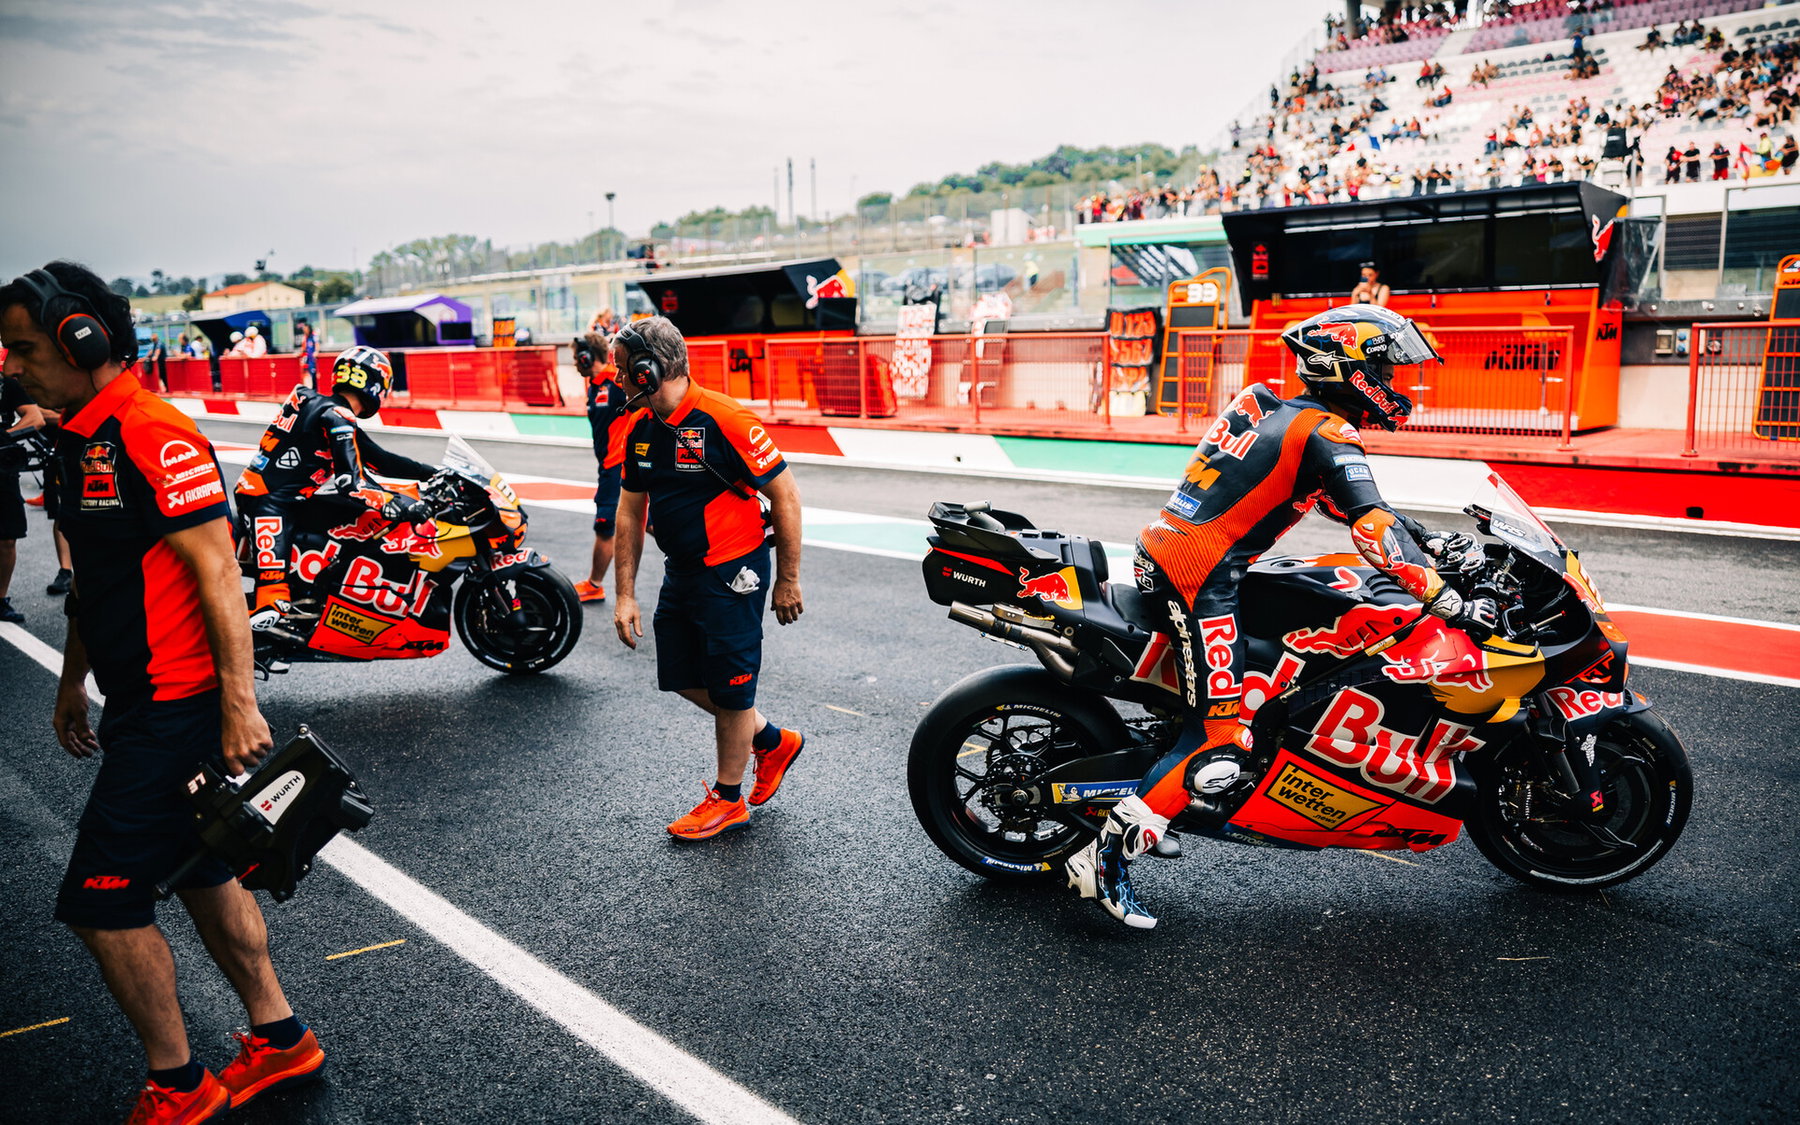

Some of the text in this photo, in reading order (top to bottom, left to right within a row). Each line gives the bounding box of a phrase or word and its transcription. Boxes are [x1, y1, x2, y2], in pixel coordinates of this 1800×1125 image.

[1596, 323, 1618, 341] KTM
[336, 365, 368, 389] 33
[1349, 369, 1400, 415] Red Bull
[1204, 417, 1260, 460] Bull
[254, 516, 285, 569] Red
[491, 547, 530, 571] Red
[259, 570, 286, 581] KTM
[340, 556, 438, 617] Bull
[332, 603, 364, 625] inter
[1198, 613, 1243, 699] Red
[1013, 704, 1062, 718] MICHELIN
[1282, 766, 1335, 800] inter
[1278, 785, 1347, 820] wetten
[83, 875, 131, 890] KTM
